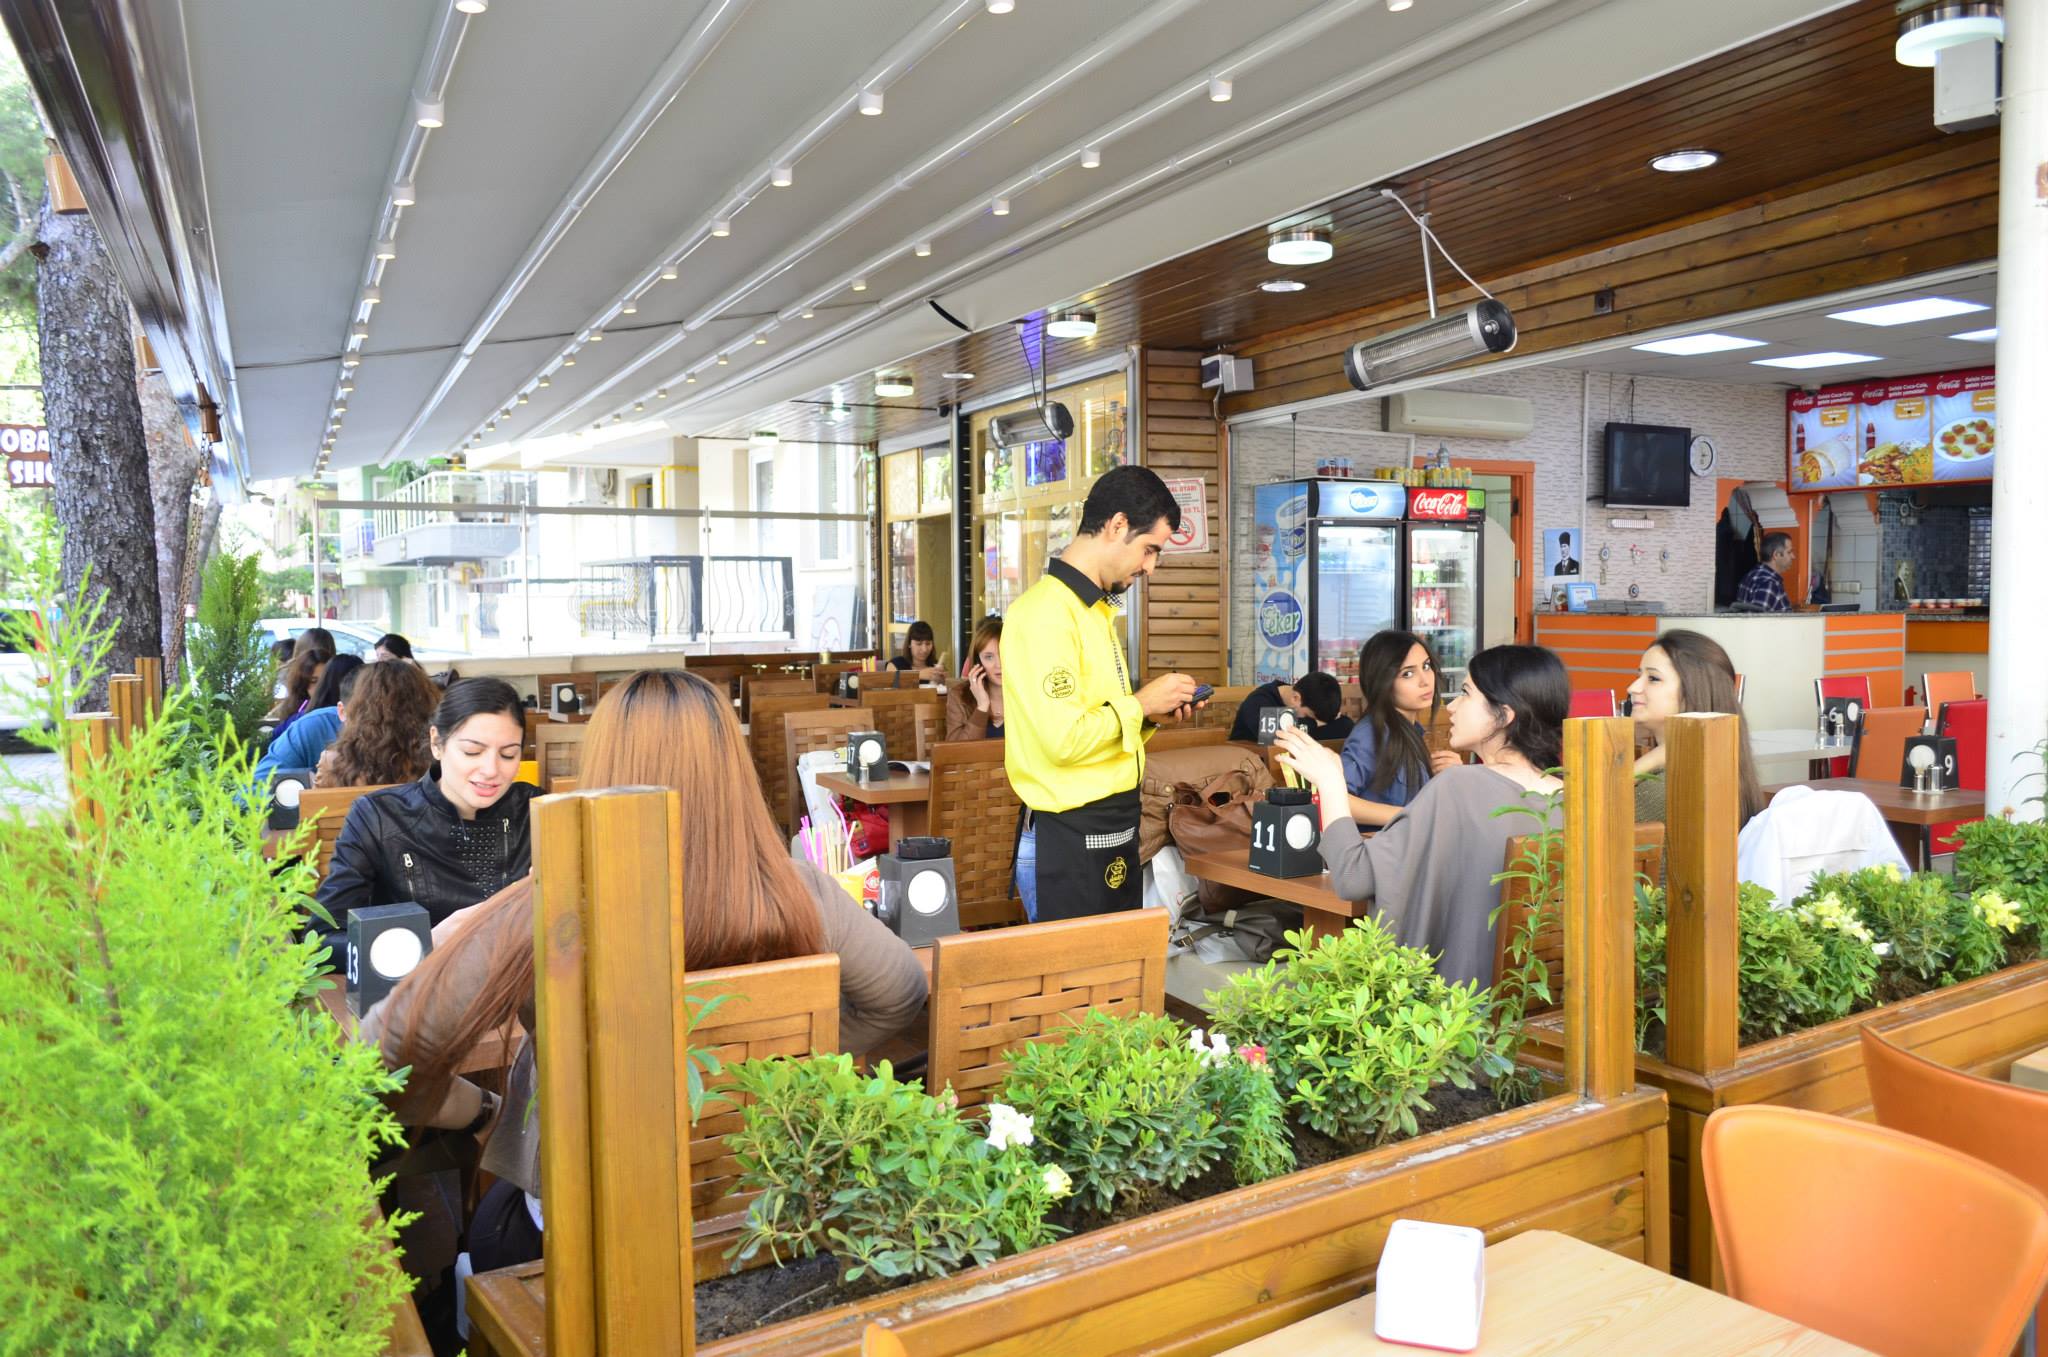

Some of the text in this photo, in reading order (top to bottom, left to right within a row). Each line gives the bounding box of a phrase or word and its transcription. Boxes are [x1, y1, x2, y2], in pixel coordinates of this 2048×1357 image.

[1260, 716, 1276, 734] 15
[1829, 707, 1837, 722] 6
[1944, 754, 1953, 776] 9
[1253, 820, 1276, 852] 11
[347, 941, 359, 985] 13
